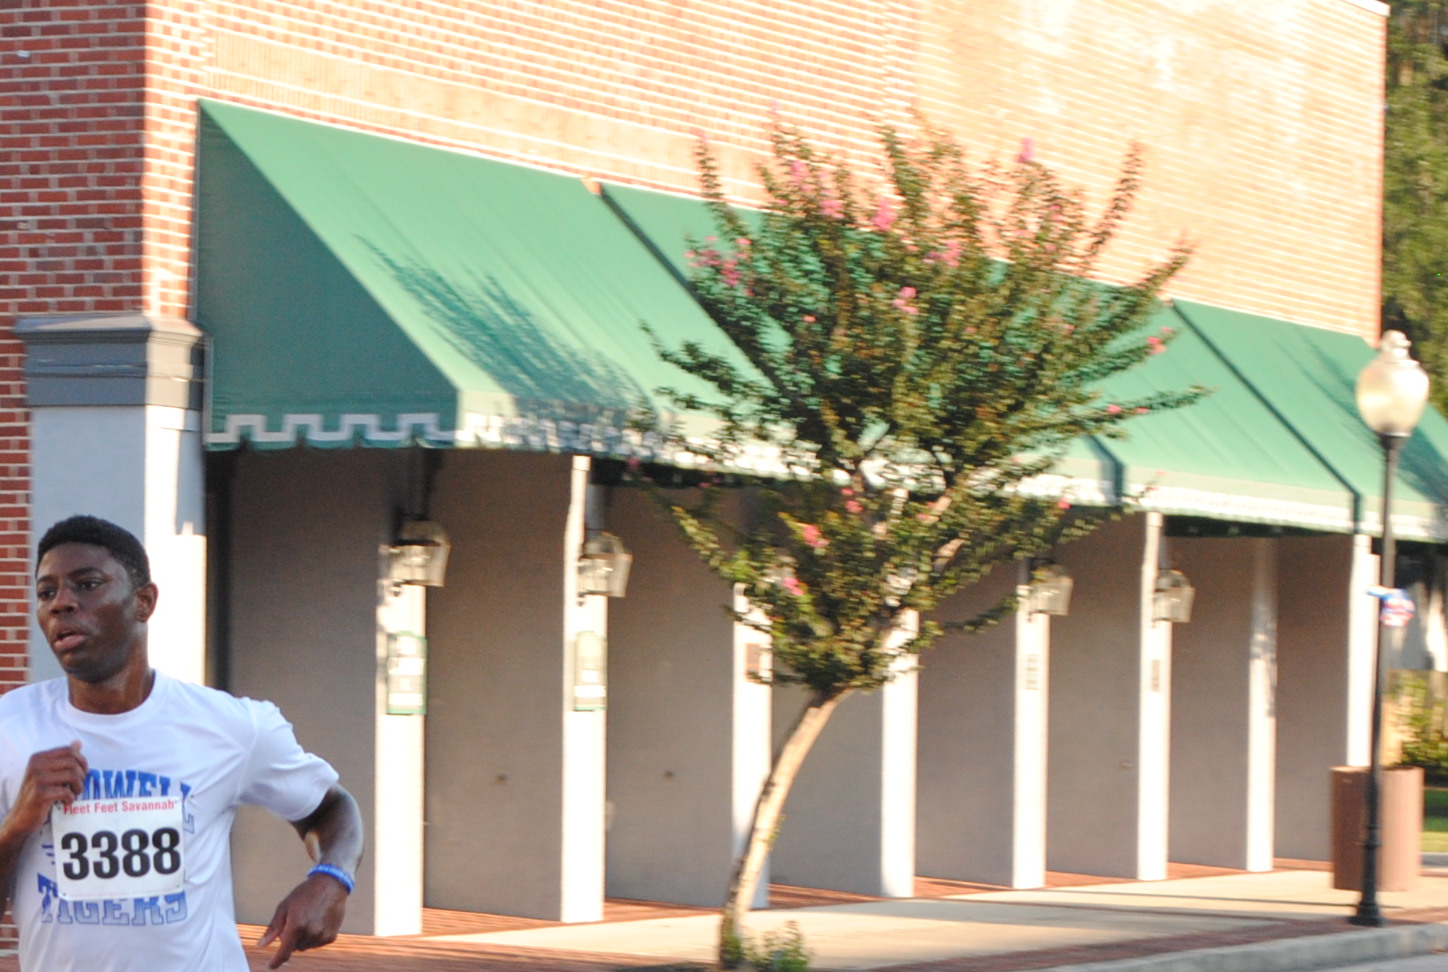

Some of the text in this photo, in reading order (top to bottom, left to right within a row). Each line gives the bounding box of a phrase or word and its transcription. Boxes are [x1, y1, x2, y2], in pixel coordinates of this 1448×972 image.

[94, 802, 119, 814] Feet
[121, 799, 175, 812] Savannah
[60, 827, 182, 881] 3388
